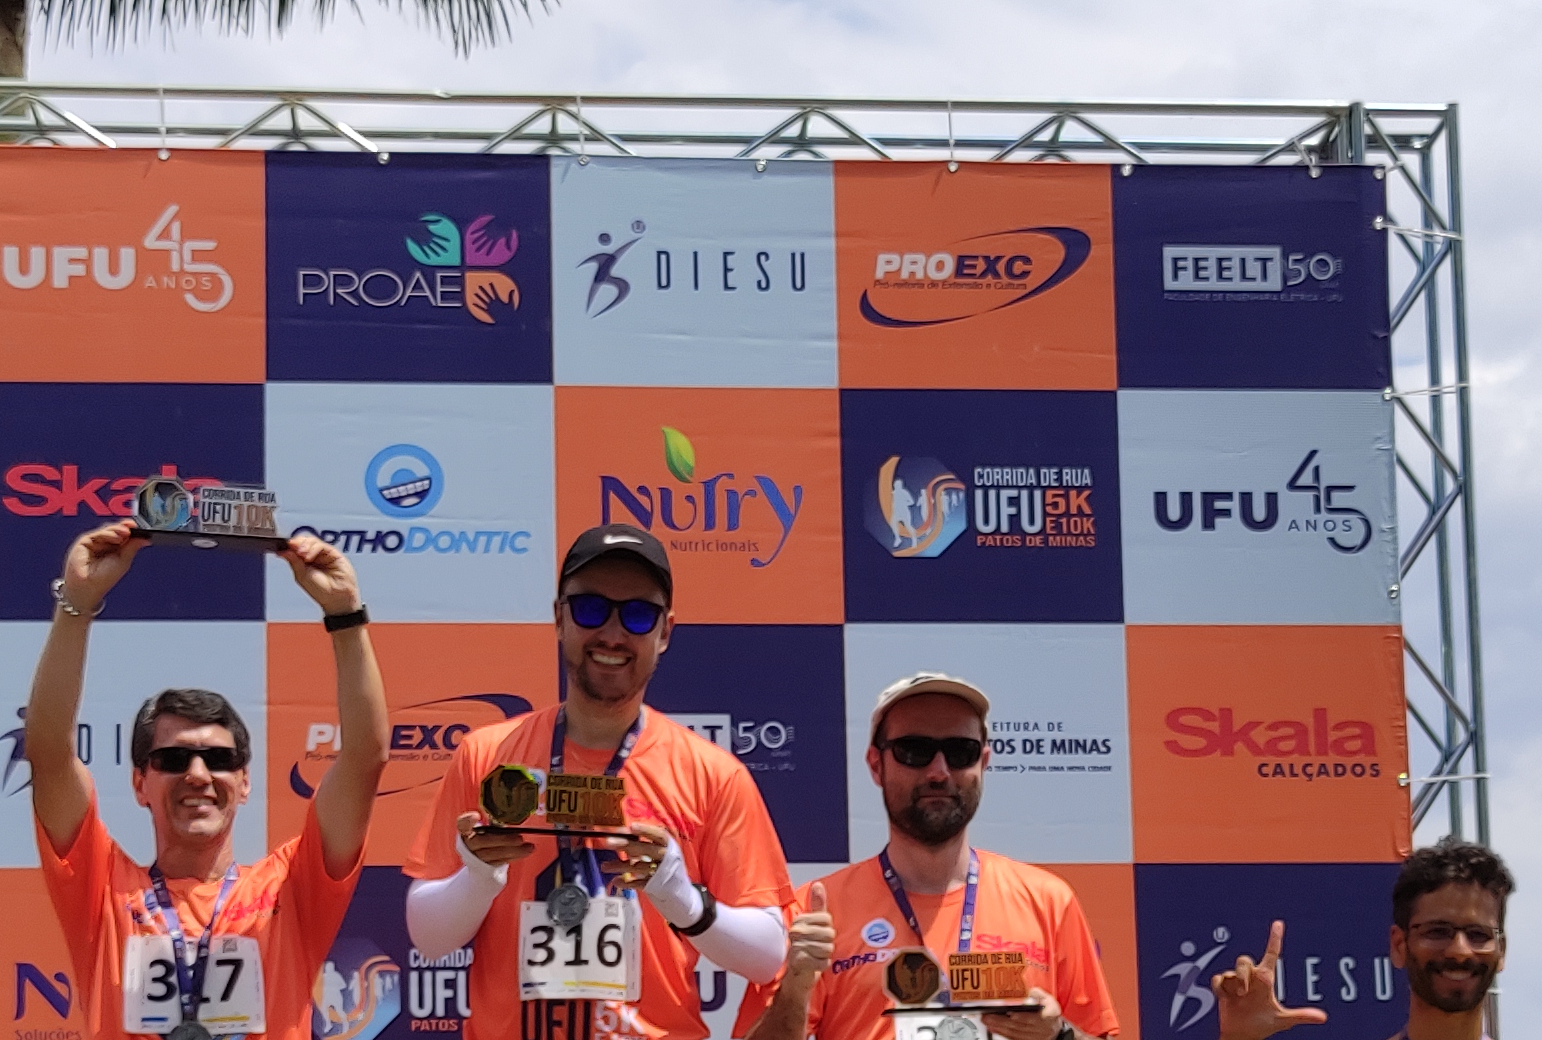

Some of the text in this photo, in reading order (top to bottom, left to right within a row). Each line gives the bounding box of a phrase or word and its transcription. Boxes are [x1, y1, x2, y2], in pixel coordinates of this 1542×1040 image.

[2, 204, 233, 312] UFU 45
[656, 250, 806, 291] DIESU
[874, 252, 1033, 281] PROEXC
[1171, 253, 1334, 286] FEELT 50
[144, 275, 212, 290] ANOS
[297, 269, 463, 307] PROAE
[2, 464, 226, 516] Ska
[974, 467, 1091, 486] CORRIDA DE RUA
[201, 501, 275, 528] UFU 10K
[974, 489, 1093, 534] UFU 5K
[1153, 449, 1373, 554] UFU 45
[1288, 519, 1352, 532] ANOS
[670, 539, 760, 552] Nutricionais
[977, 535, 1095, 547] PATOS DE MINAS
[305, 723, 470, 751] PEXC
[736, 721, 787, 755] 50
[992, 721, 1064, 732] EITURA DE
[1163, 706, 1378, 758] Skala
[988, 738, 1112, 755] TOS DE MINAS
[1258, 762, 1381, 782] CALÇADOS
[547, 789, 578, 813] UFU
[527, 923, 623, 967] 316
[146, 958, 245, 1003] 37
[950, 968, 980, 990] UFU
[981, 965, 1028, 992] 10K
[1274, 956, 1392, 1001] IESU
[411, 1018, 458, 1031] PATOS
